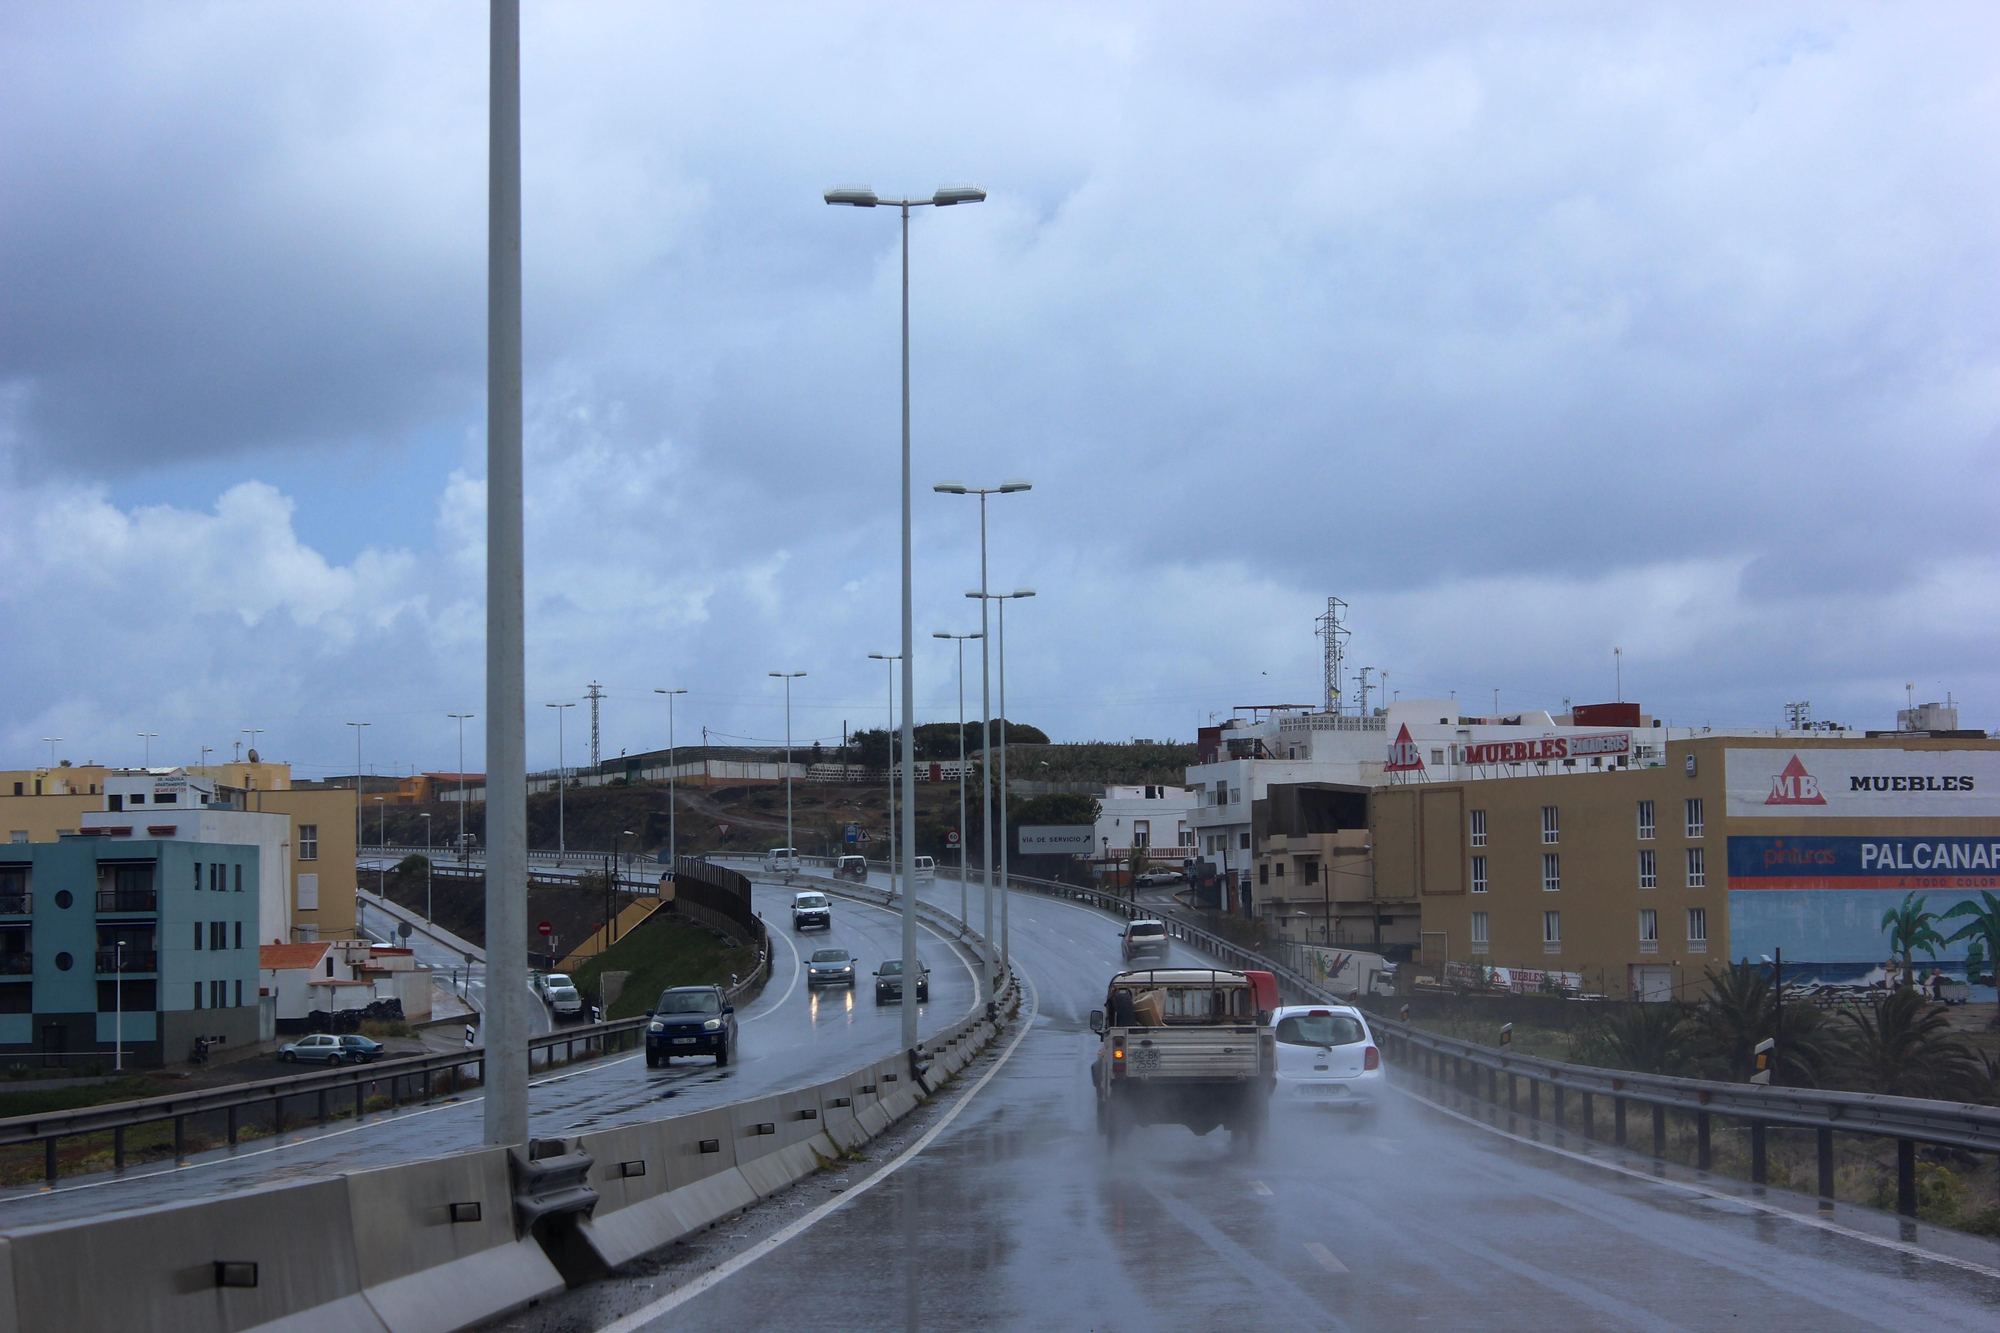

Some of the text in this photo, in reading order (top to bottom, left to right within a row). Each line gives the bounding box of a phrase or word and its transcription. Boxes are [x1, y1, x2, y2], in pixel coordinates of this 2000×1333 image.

[1387, 742, 1419, 766] MB
[1465, 738, 1568, 764] MUEBLES
[1771, 775, 1975, 799] MB MUEBLES
[1765, 840, 1836, 868] pinturas
[1899, 878, 1996, 887] A TODO COLOR
[1509, 970, 1544, 983] UEBLES
[1134, 1050, 1159, 1060] GC-BK
[1136, 1060, 1157, 1069] 2555
